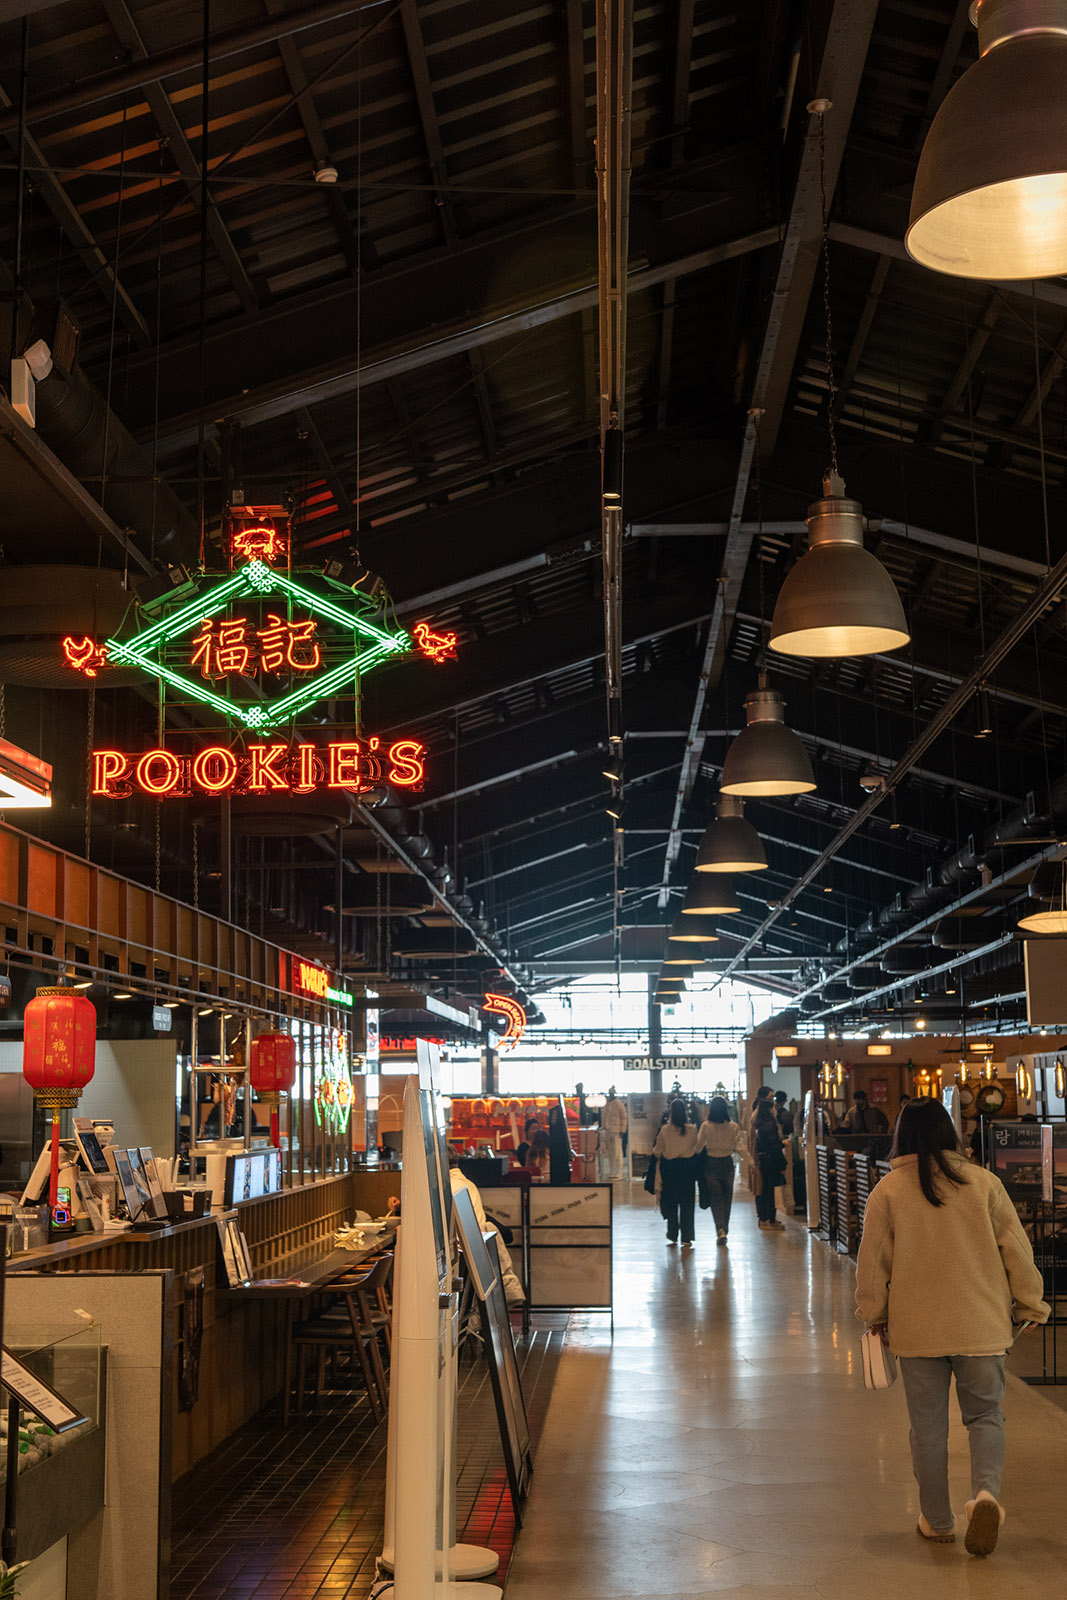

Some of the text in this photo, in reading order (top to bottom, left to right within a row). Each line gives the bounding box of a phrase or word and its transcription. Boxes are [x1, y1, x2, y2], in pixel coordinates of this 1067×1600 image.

[190, 613, 320, 675] 福記
[92, 737, 424, 794] POOKIE'S
[494, 999, 513, 1011] OPEN
[624, 1057, 701, 1070] GOALSTUDIO
[995, 1129, 1011, 1146] 랑
